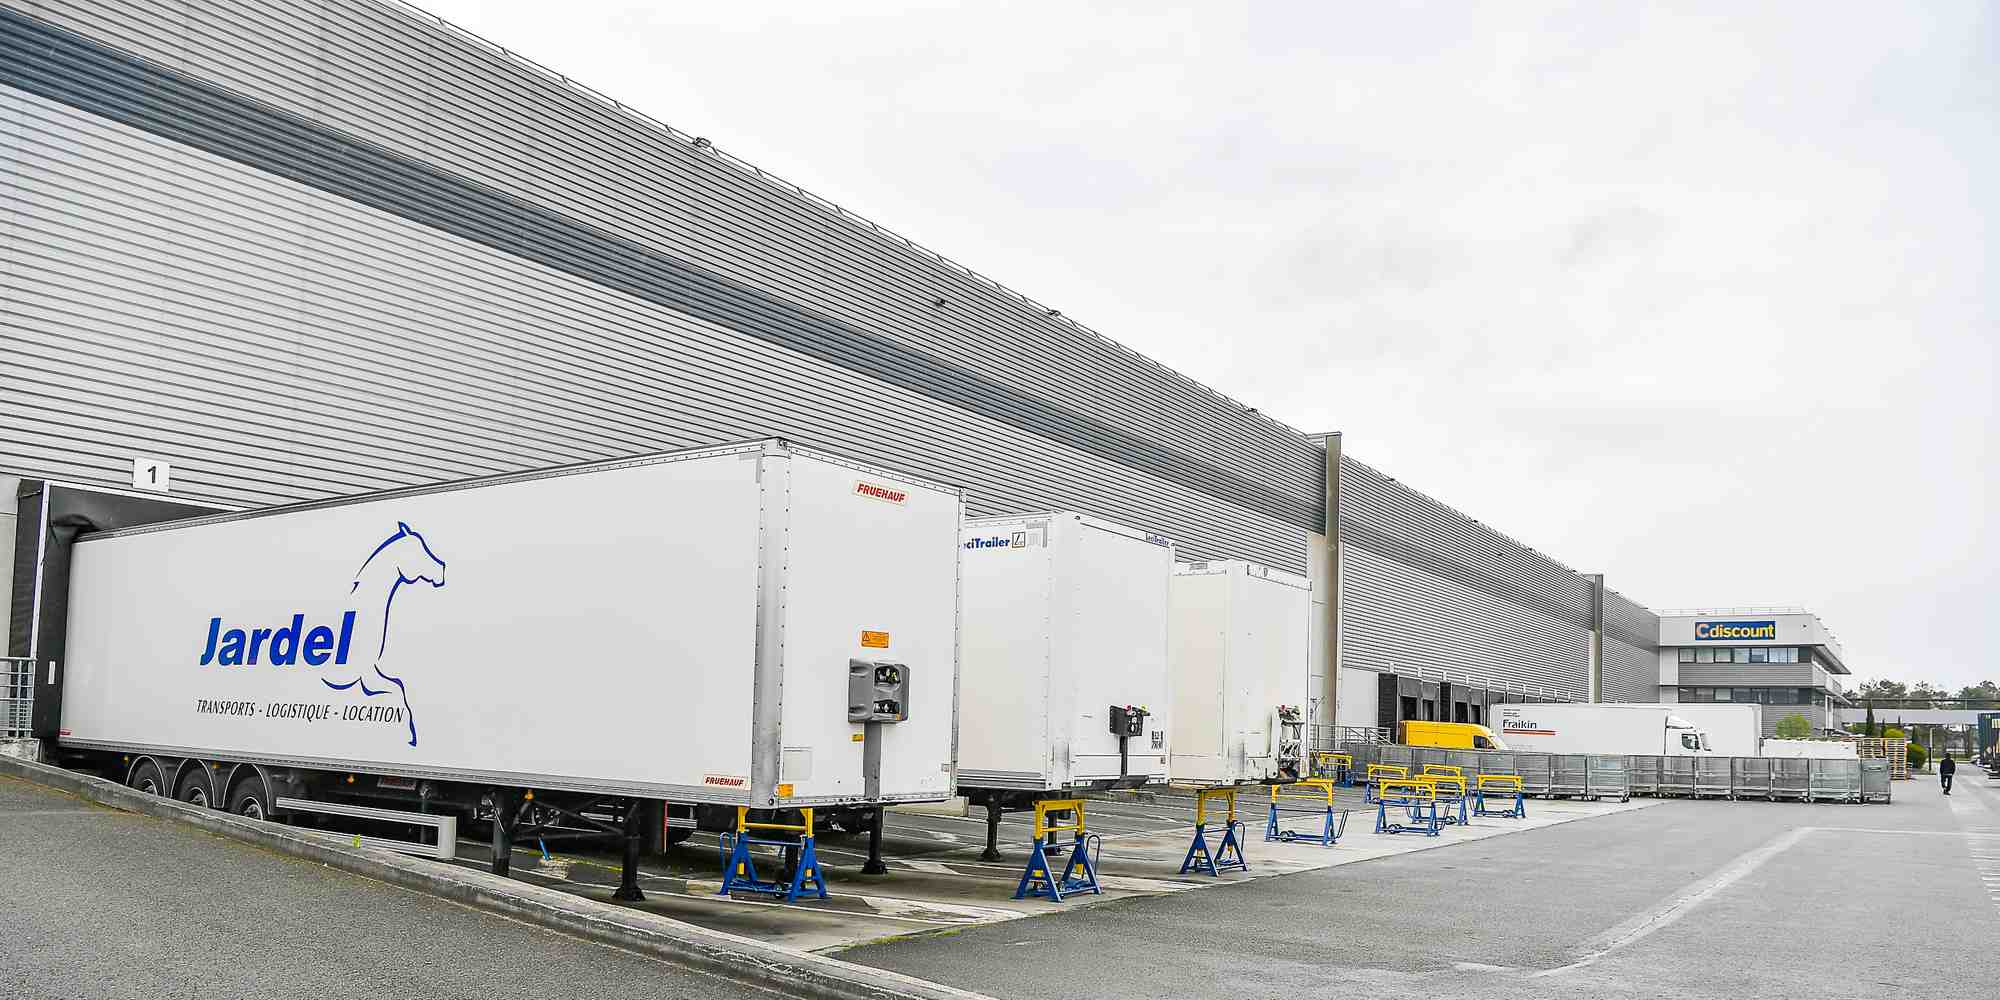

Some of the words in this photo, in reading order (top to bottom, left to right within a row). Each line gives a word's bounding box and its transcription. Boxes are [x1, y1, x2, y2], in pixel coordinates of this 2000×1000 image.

[147, 465, 157, 484] 1
[856, 483, 906, 503] FRUEHAUF
[199, 610, 357, 667] Jardel
[1696, 623, 1774, 638] Cdiscount
[196, 699, 256, 717] TRANSPORTS
[265, 703, 331, 723] LOGISTIQUE
[342, 704, 405, 724] LOCATION
[1502, 719, 1537, 729] Fraikin
[705, 776, 744, 786] FRUEHAUF
